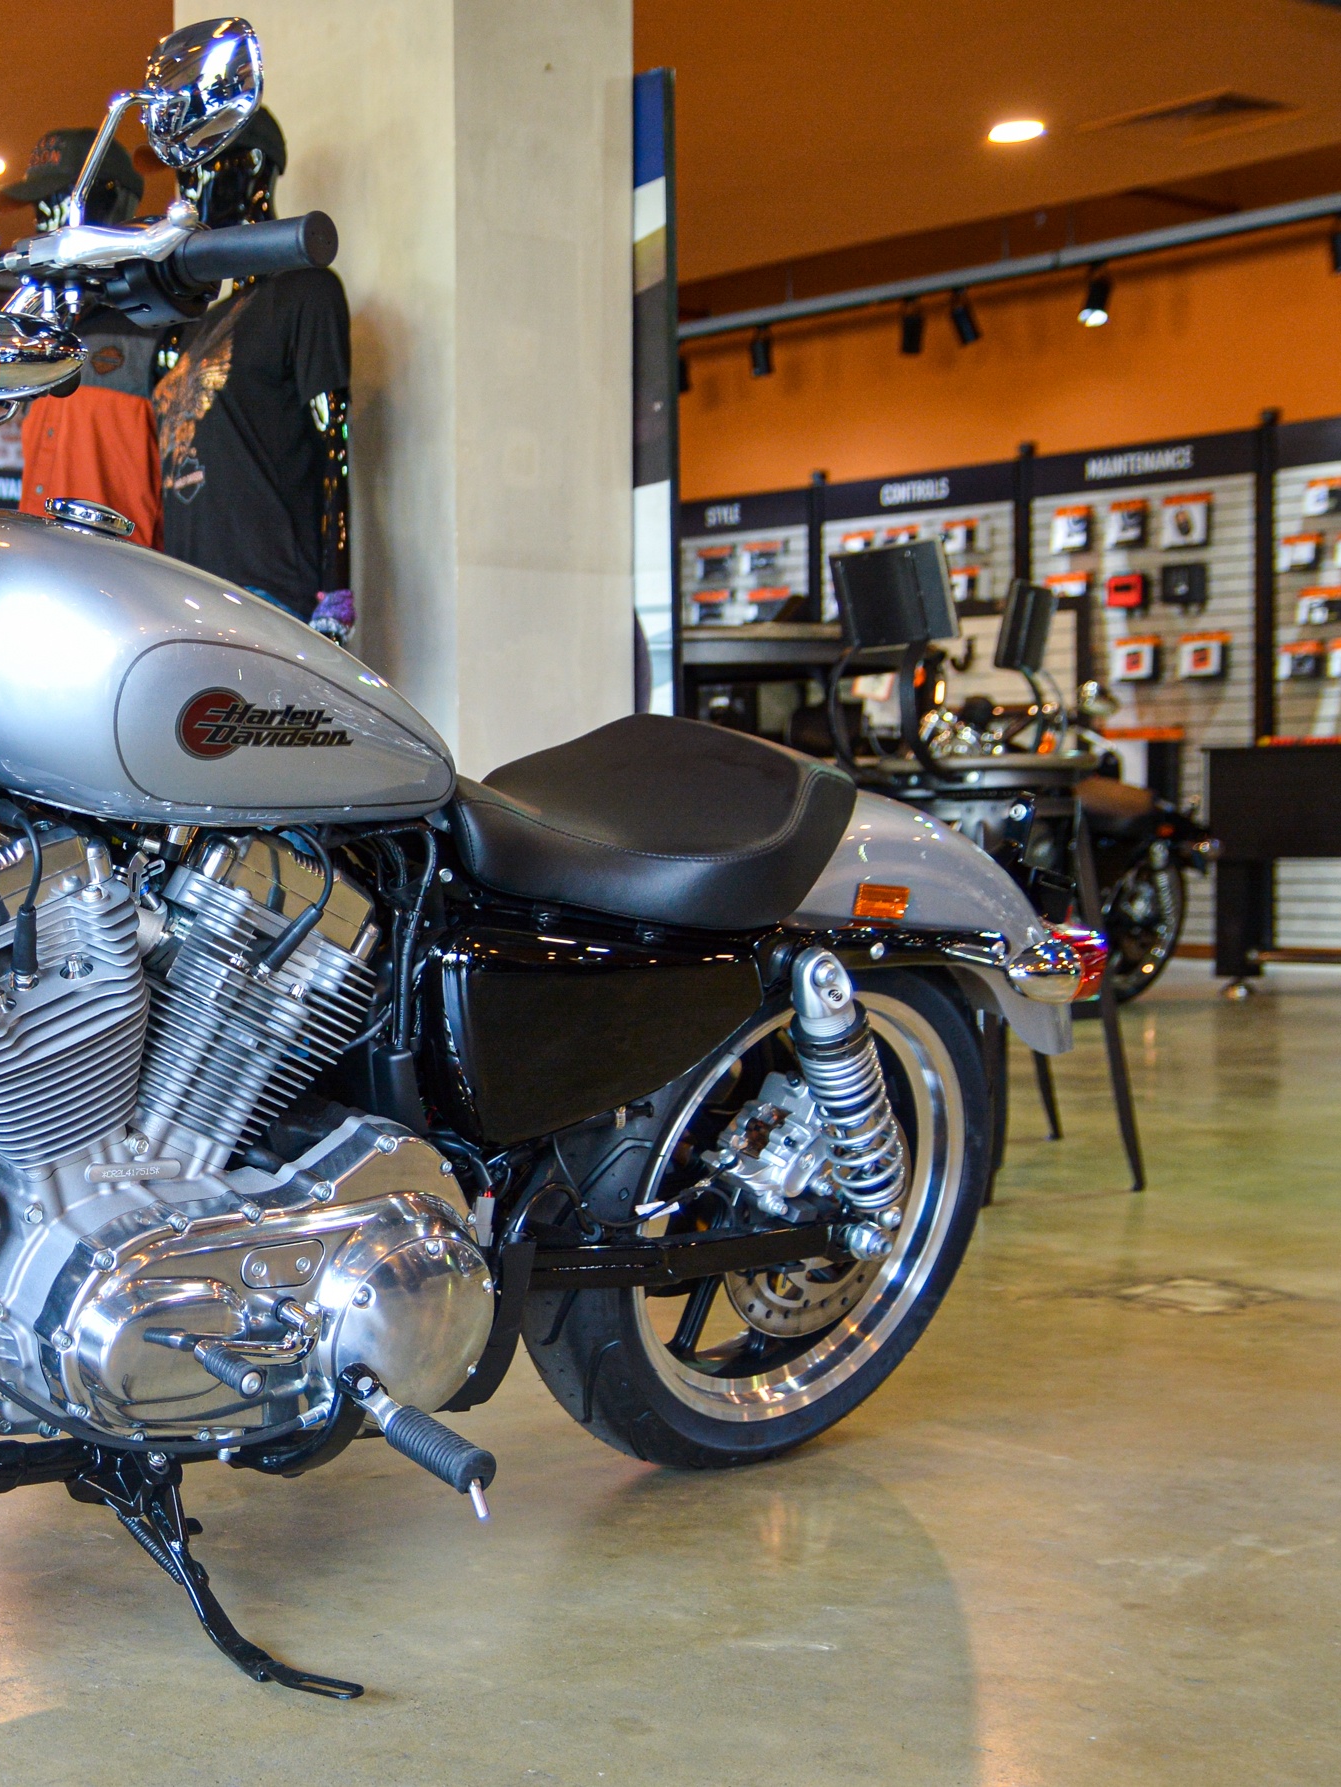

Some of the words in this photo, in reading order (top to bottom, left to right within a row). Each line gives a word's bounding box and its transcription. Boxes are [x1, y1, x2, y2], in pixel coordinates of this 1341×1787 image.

[1084, 444, 1194, 481] MAINTENANCE
[879, 476, 950, 507] CONTROLS
[704, 502, 742, 528] STYLE
[196, 722, 354, 748] Davidson
